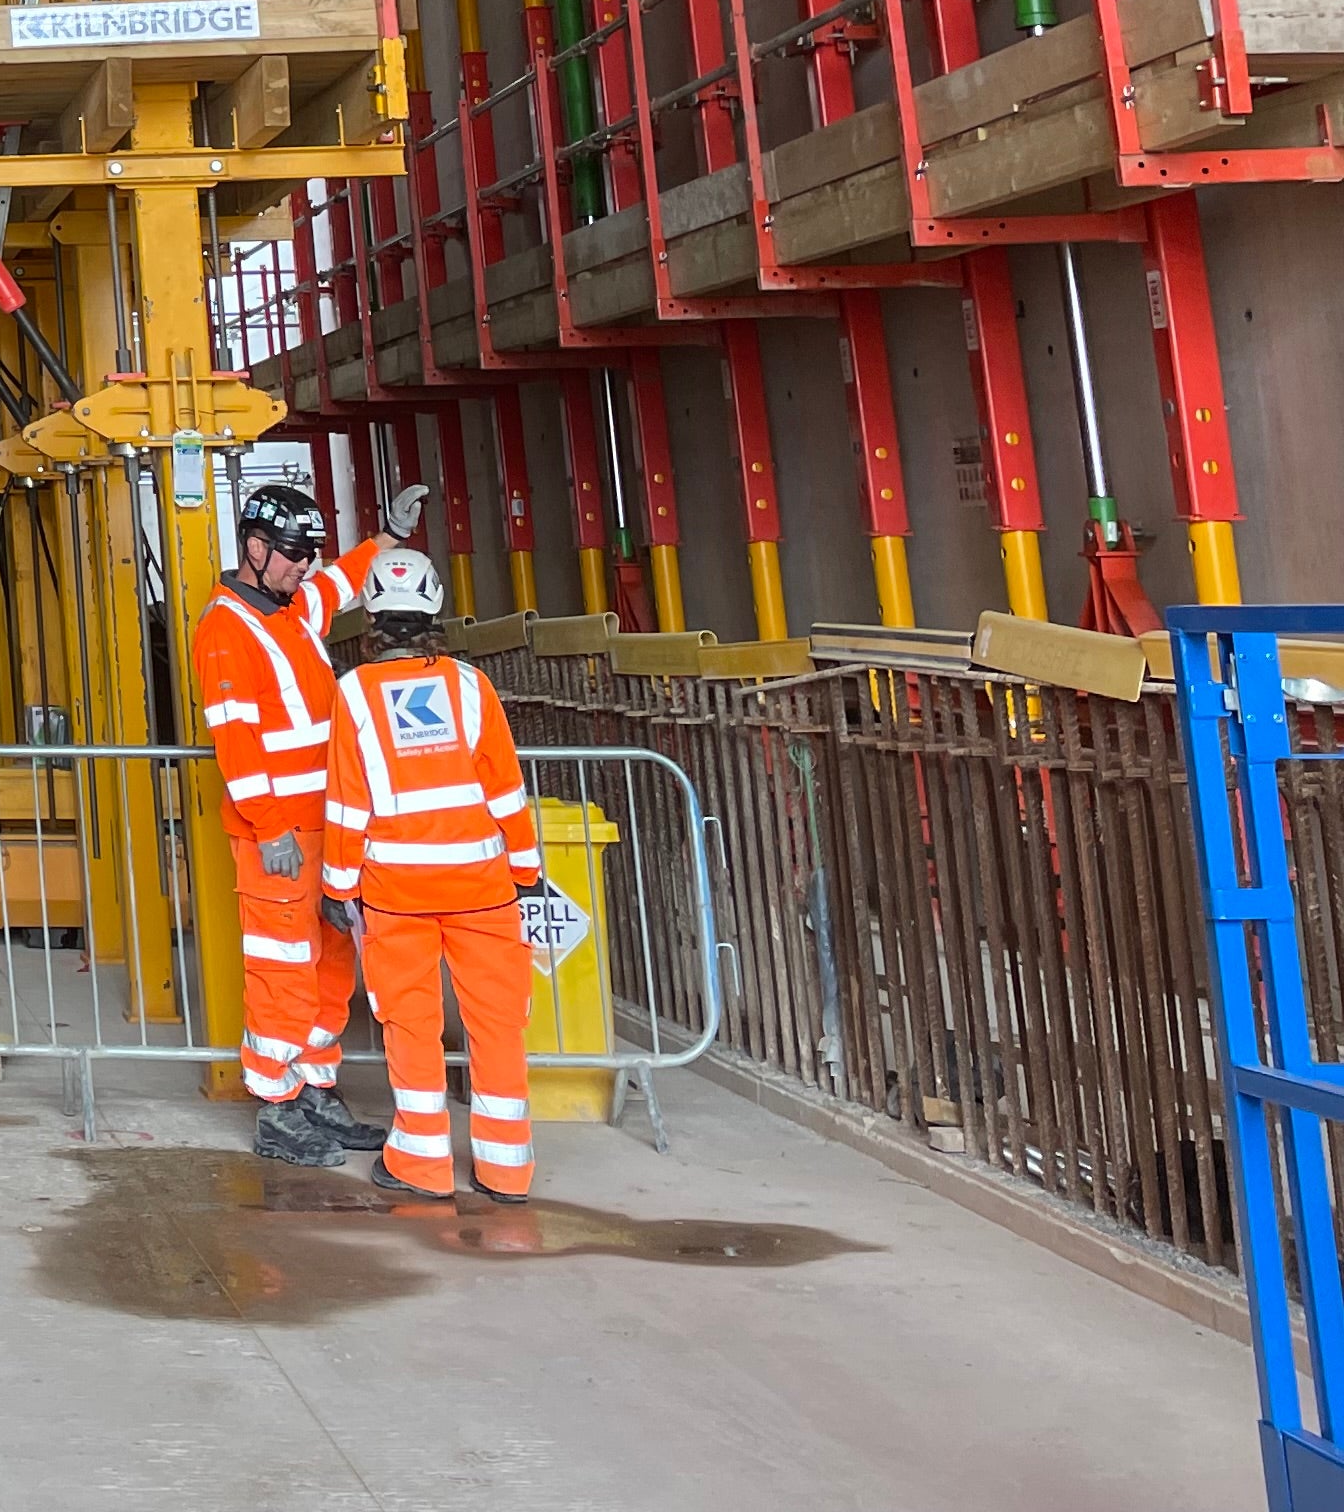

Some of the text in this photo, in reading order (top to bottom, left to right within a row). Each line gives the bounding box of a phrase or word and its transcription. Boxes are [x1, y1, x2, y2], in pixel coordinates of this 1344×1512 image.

[50, 5, 253, 40] KILNBRIDGE
[399, 727, 450, 740] KILNBRIDGE
[527, 925, 565, 944] KIT
